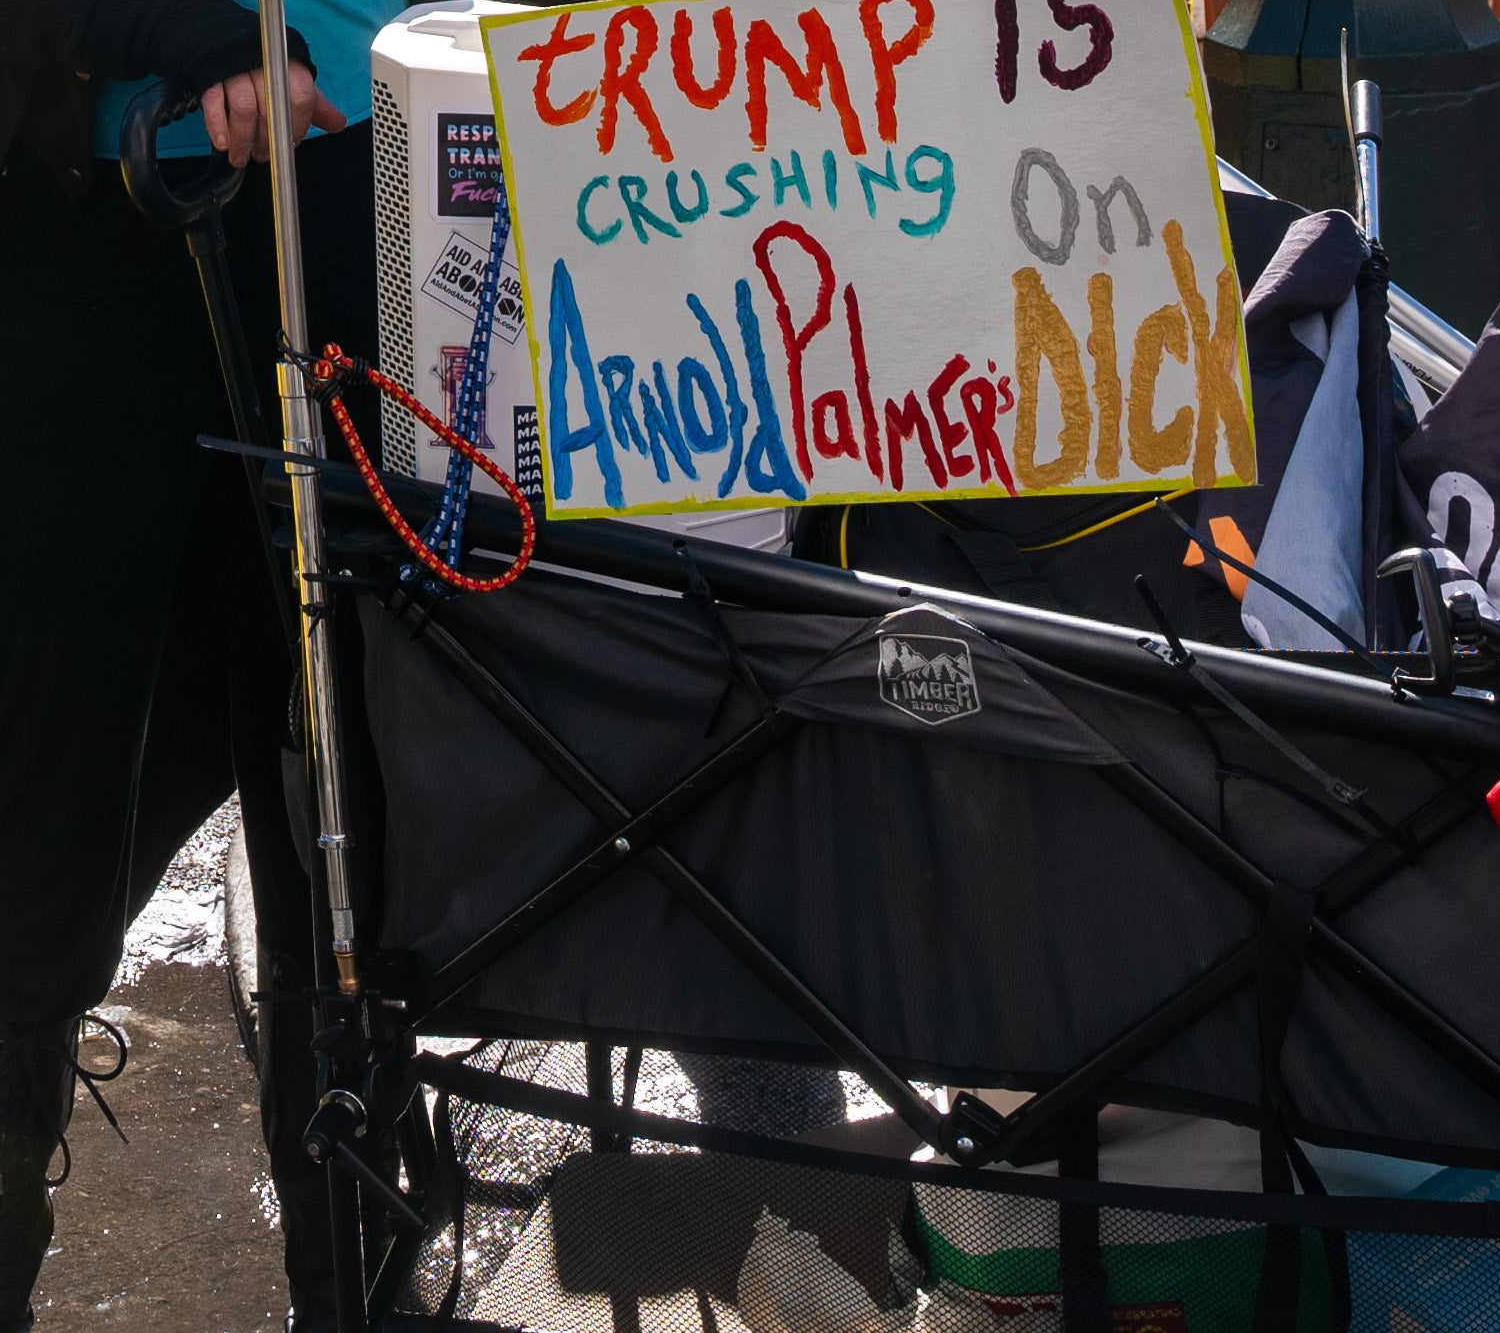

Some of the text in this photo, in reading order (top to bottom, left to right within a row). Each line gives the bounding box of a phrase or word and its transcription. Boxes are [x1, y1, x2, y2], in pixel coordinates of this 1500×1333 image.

[448, 167, 464, 180] Or
[467, 167, 487, 180] I'm
[445, 244, 472, 267] AID
[891, 680, 973, 710] TIMBER
[911, 700, 954, 714] RIDGE
